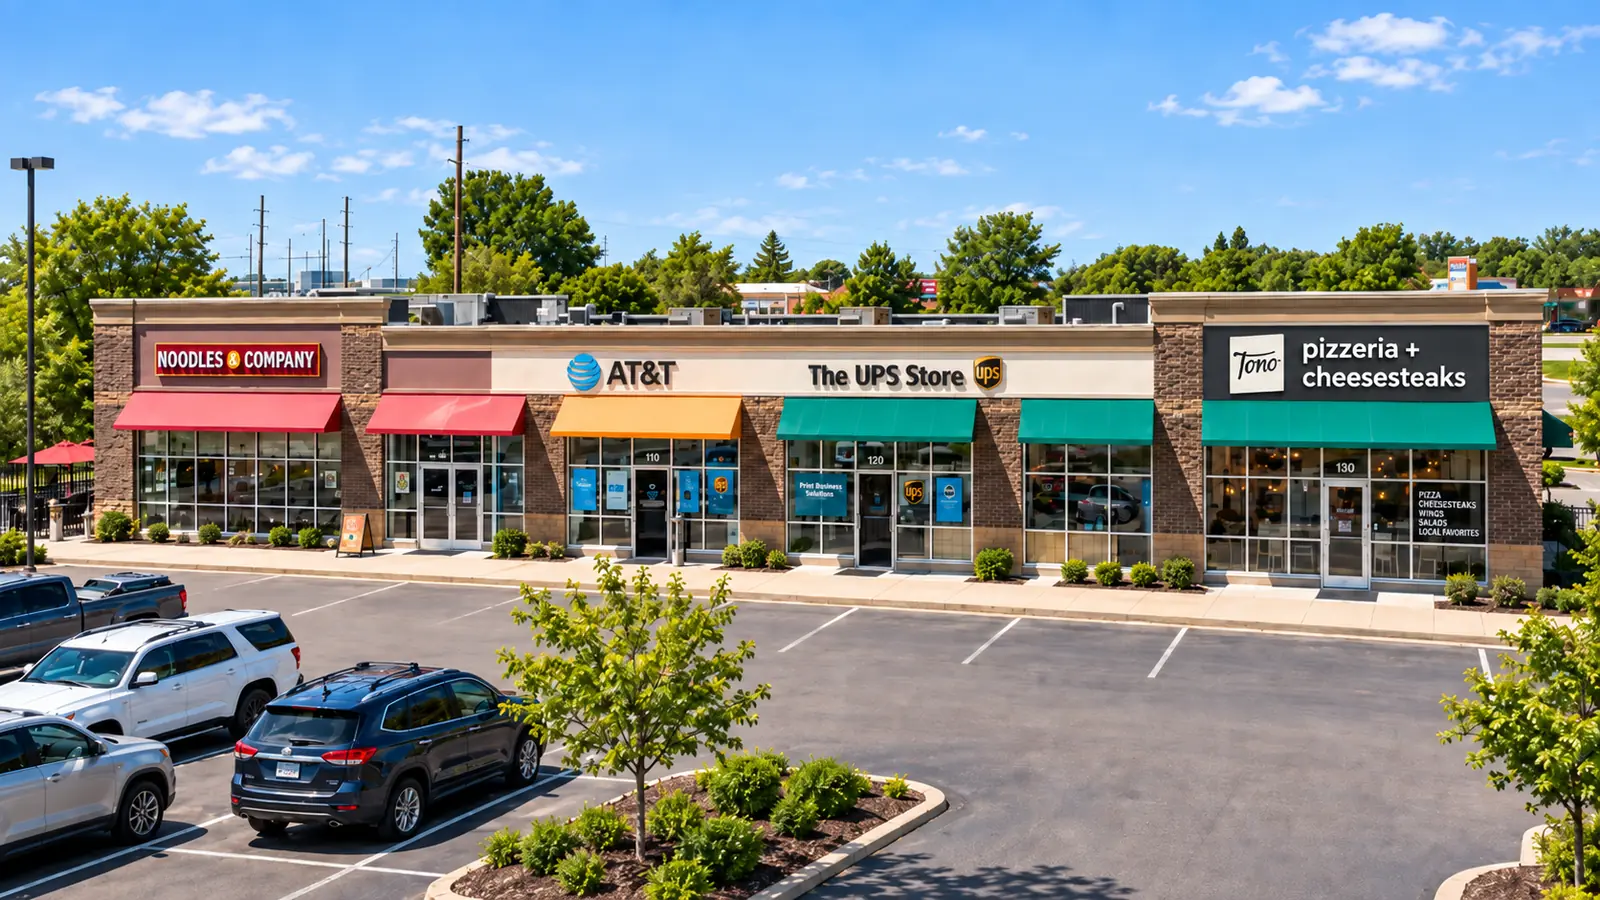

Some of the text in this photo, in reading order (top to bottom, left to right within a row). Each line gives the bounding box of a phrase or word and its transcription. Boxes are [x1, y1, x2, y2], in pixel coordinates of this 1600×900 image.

[158, 350, 314, 368] NOODLES & COMPANY
[1302, 337, 1399, 365] pizzeria
[607, 360, 677, 386] AT&T
[1233, 350, 1279, 380] Tono
[808, 364, 964, 386] The UPS Store
[976, 366, 1000, 385] ups
[1302, 365, 1467, 389] cheesesteaks
[645, 452, 660, 462] 110
[867, 455, 884, 465] 120
[1335, 462, 1355, 473] 130
[799, 481, 815, 489] Print
[905, 486, 924, 501] ups
[1418, 490, 1442, 499] PIZZA
[1418, 527, 1480, 537] LOCAL FAVORITES
